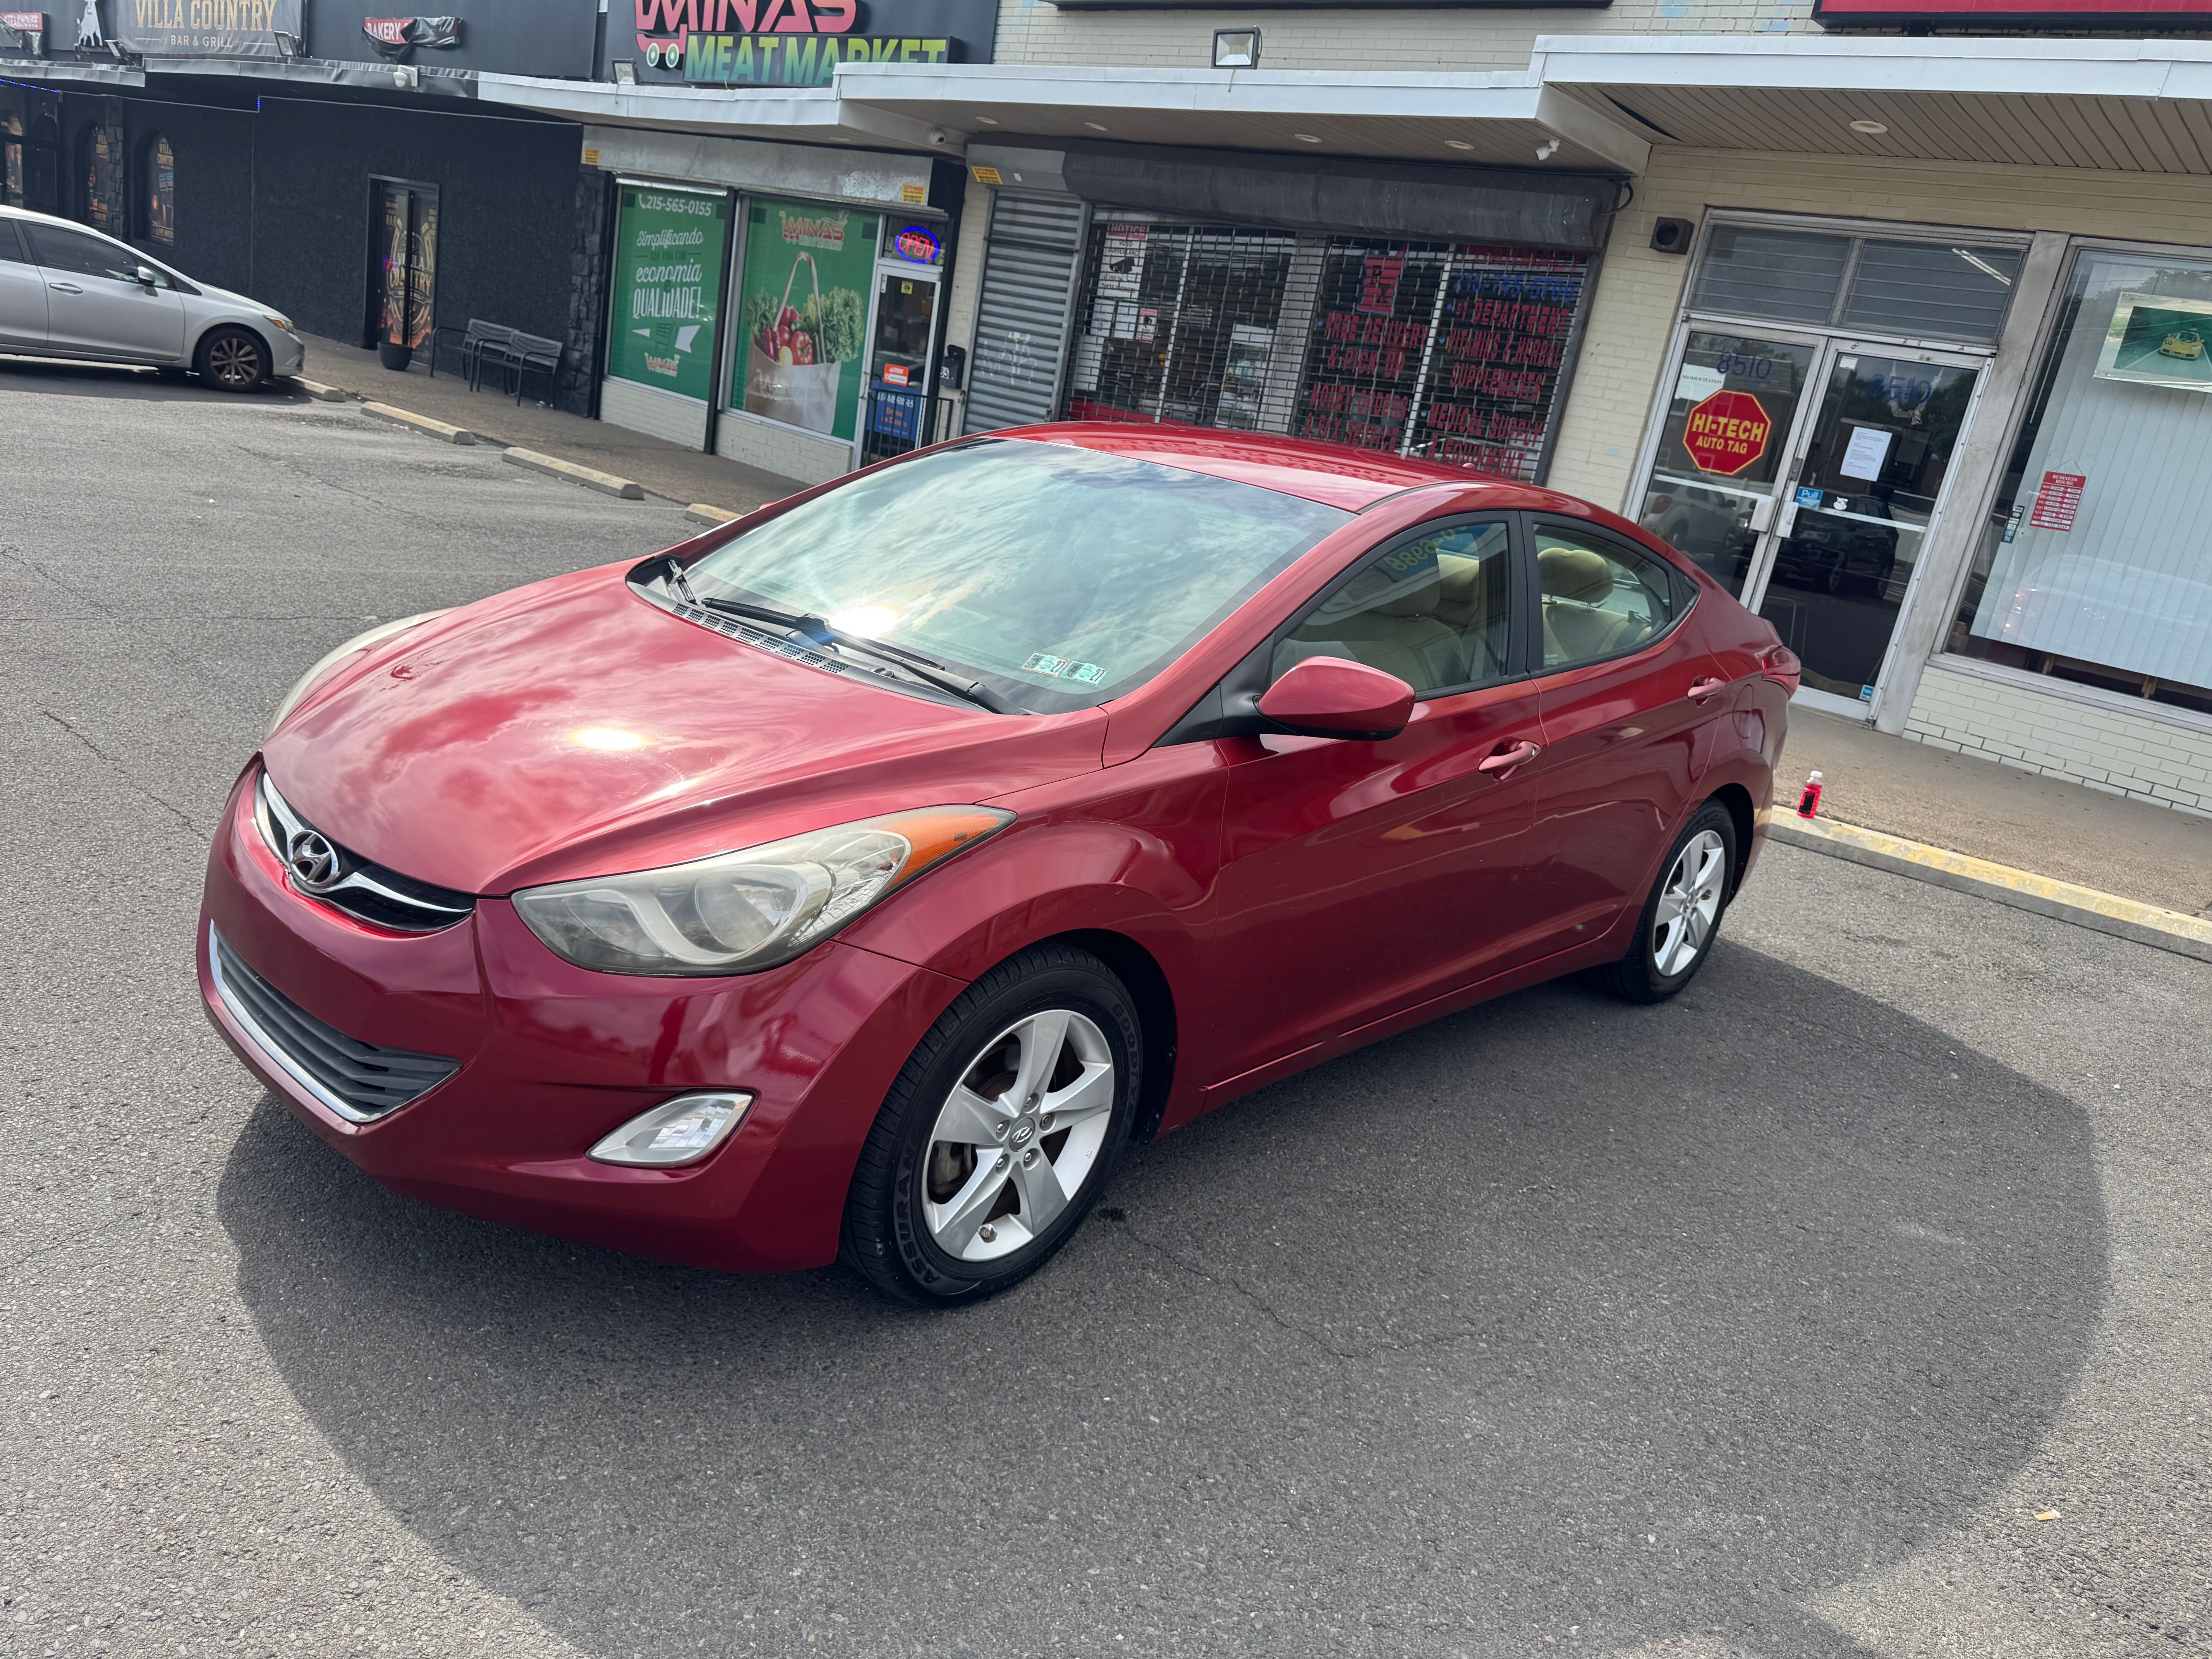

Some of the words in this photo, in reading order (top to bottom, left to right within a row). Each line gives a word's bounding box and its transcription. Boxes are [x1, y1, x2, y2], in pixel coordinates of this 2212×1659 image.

[136, 0, 185, 28] VILLA
[190, 0, 276, 31] COUNTRY
[170, 35, 189, 45] BAR
[193, 36, 199, 46] &
[203, 36, 232, 47] GRILL
[367, 22, 400, 40] BAKERY
[685, 35, 779, 82] MEAT
[646, 195, 713, 216] 215-565-0155
[637, 227, 704, 250] Simplificando
[780, 212, 845, 241] MINAS
[898, 232, 936, 260] OPEN
[636, 259, 702, 282] economia
[633, 286, 702, 319] QUALIDADE!
[1474, 297, 1570, 335] DEPARTMENT
[1364, 317, 1428, 349] DELIVERY
[1448, 329, 1501, 360] VITAMINS
[1515, 336, 1562, 369] HERBAL
[1343, 347, 1378, 375] PICK
[1384, 352, 1406, 383] UP
[1716, 352, 1772, 380] 8510
[1450, 362, 1543, 402] SUPPLEMENTS
[1867, 374, 1932, 404] 8510
[1310, 383, 1353, 413] MONEY
[1357, 389, 1408, 421] ORDERS
[1427, 403, 1484, 436] MEDICAL
[1488, 412, 1544, 448] SUPPLY
[1692, 413, 1764, 442] HI-TECH
[1696, 436, 1725, 450] AUTO
[1728, 440, 1748, 454] TAG
[1802, 489, 1819, 499] Pull
